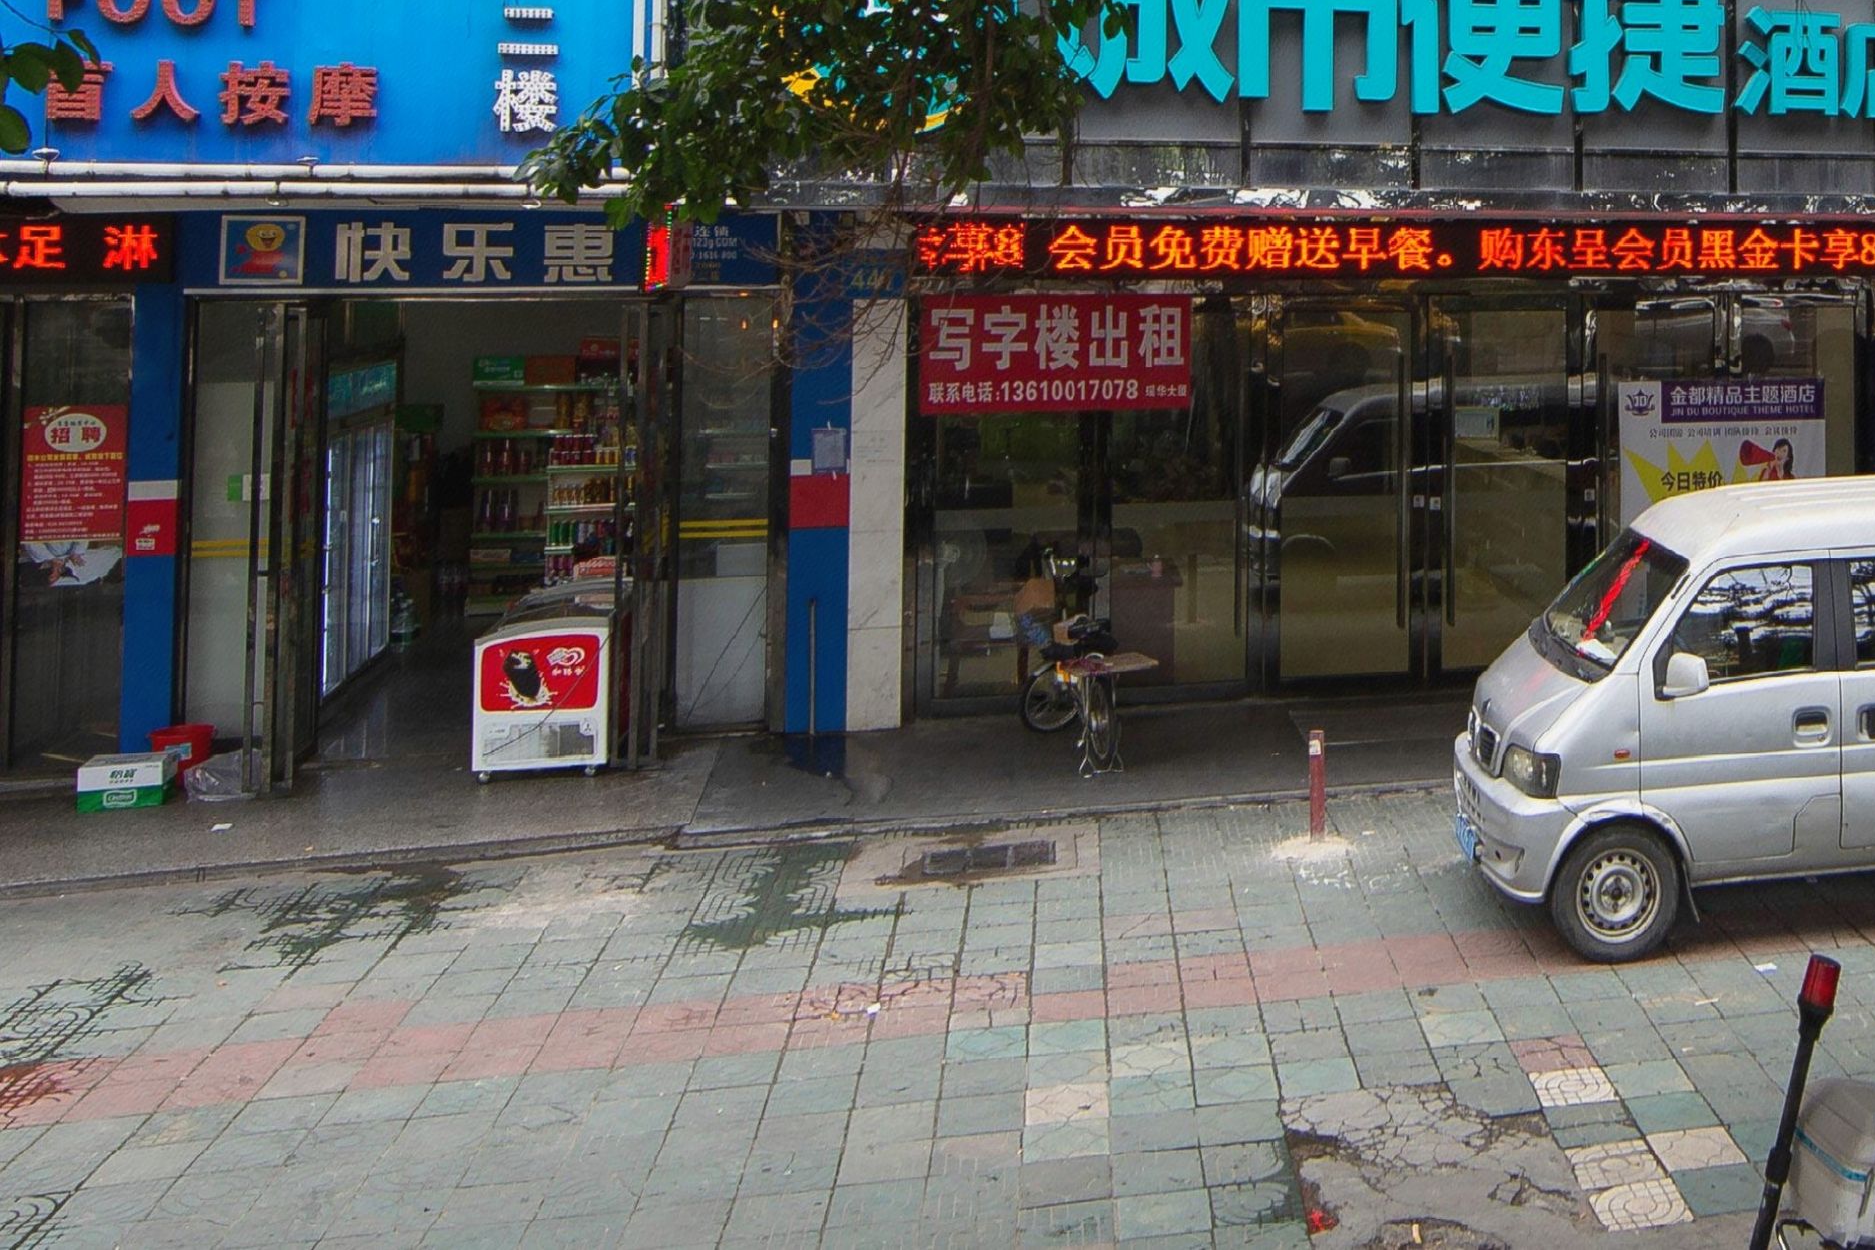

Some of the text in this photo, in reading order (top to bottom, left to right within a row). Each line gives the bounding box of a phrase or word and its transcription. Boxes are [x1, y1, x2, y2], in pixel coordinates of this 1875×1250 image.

[493, 6, 559, 133] 二楼
[0, 224, 66, 269] 足
[334, 221, 614, 283] 快乐惠
[928, 306, 1185, 371] 写字楼出租
[1670, 385, 1816, 406] 金都精品主题酒店
[1670, 403, 1815, 416] JIN DU BOUTIQUE THEME HOTEL
[51, 427, 101, 443] 招聘
[1661, 471, 1723, 491] 今日特价
